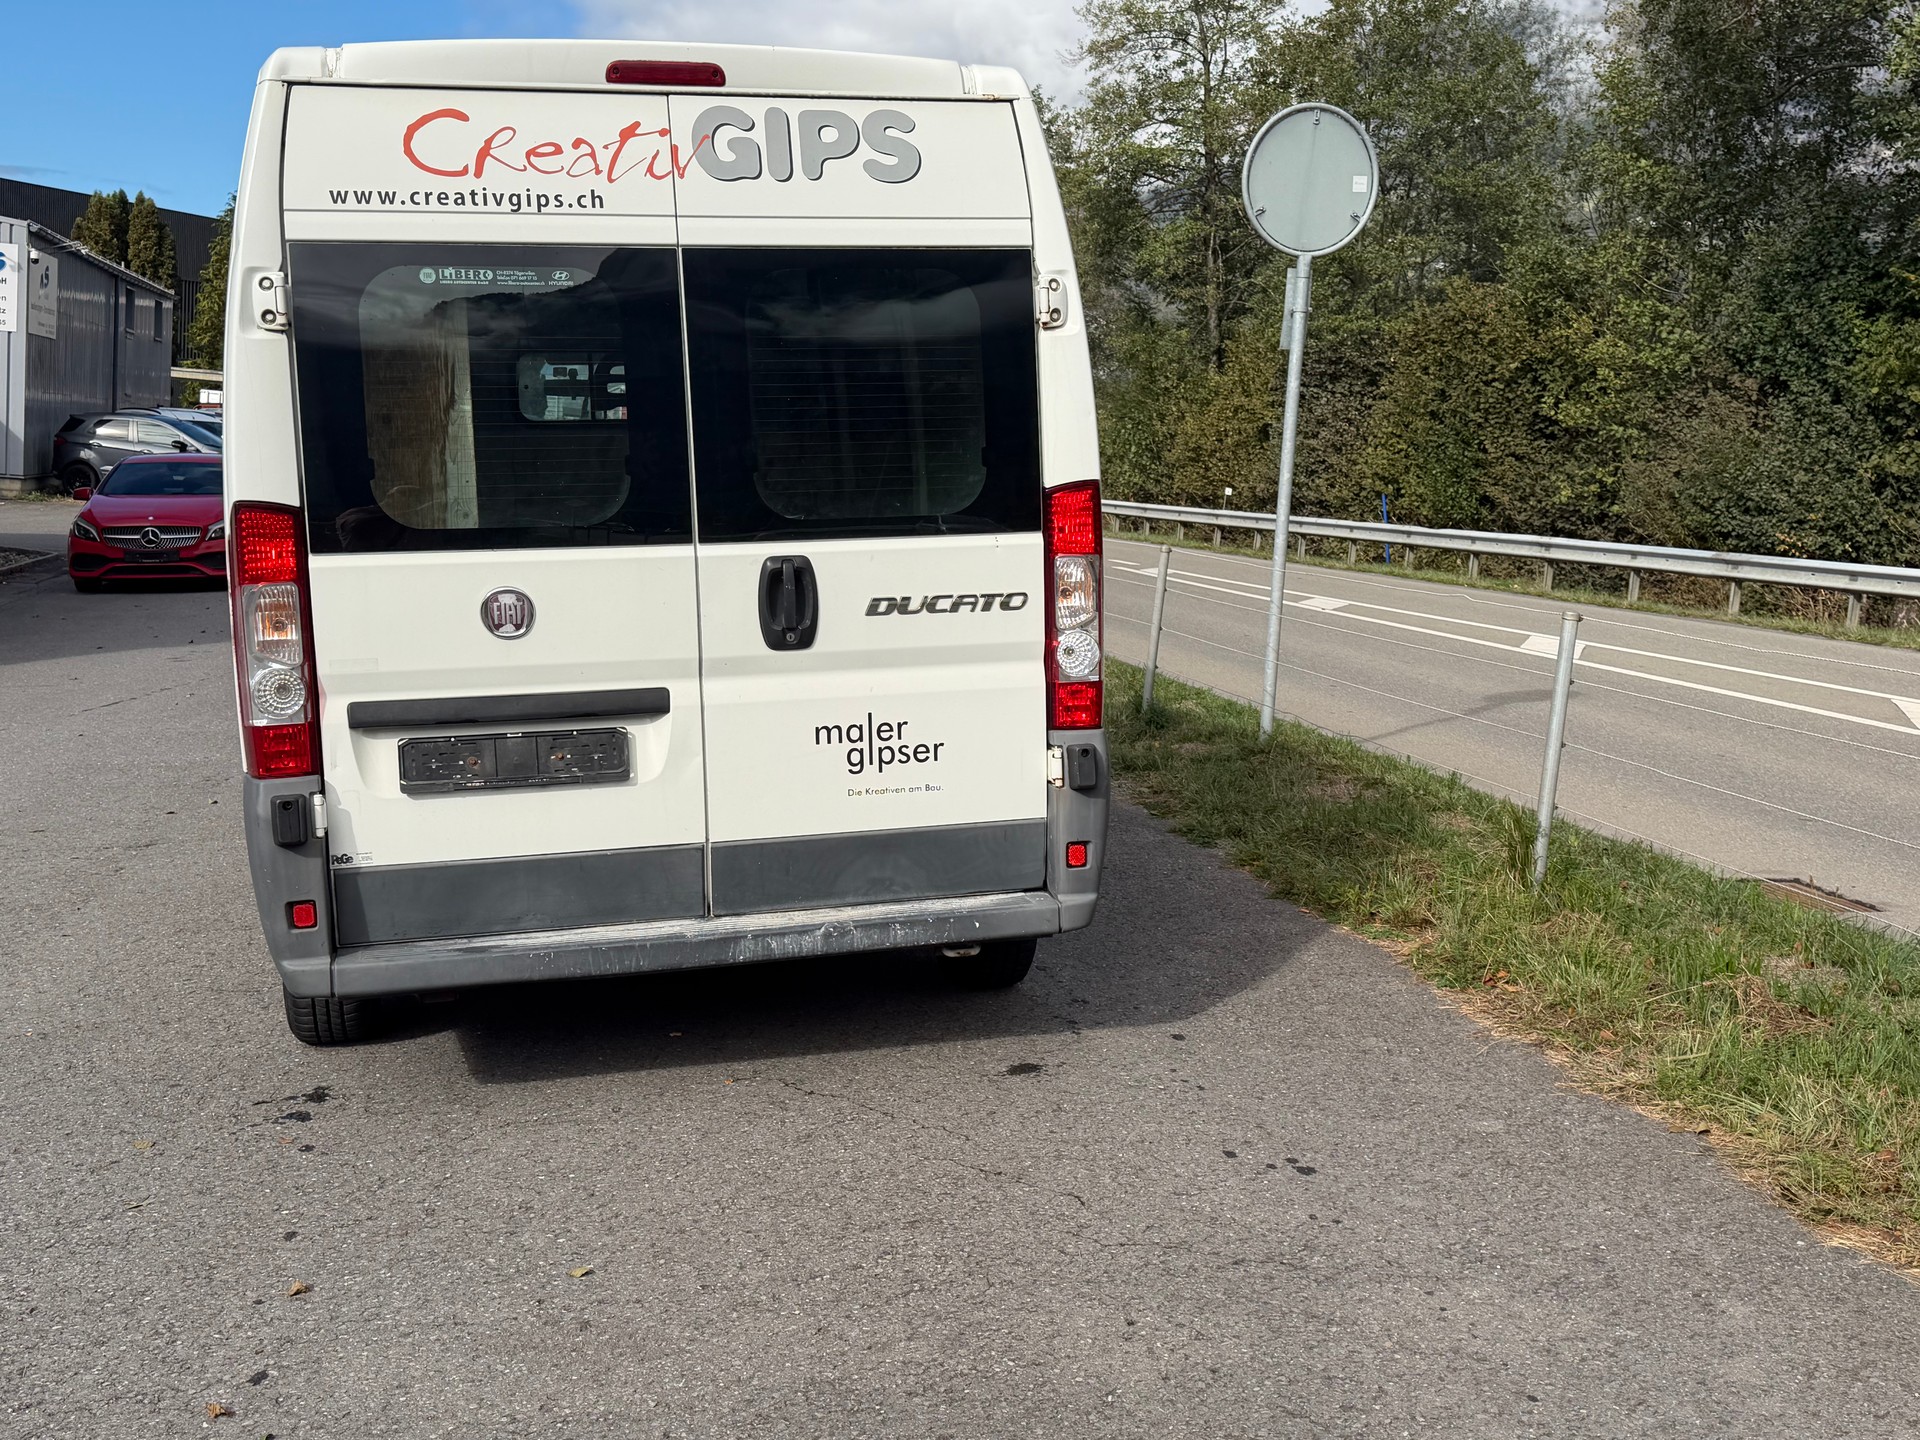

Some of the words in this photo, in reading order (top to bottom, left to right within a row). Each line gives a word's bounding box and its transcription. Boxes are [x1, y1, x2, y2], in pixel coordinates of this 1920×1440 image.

[692, 105, 922, 184] GIPS
[329, 187, 605, 213] www.creativgips.ch
[493, 601, 523, 625] FIAT
[864, 591, 1029, 617] DUCATO
[815, 712, 909, 746] maler
[847, 788, 863, 797] Die
[865, 786, 906, 796] Kreativen
